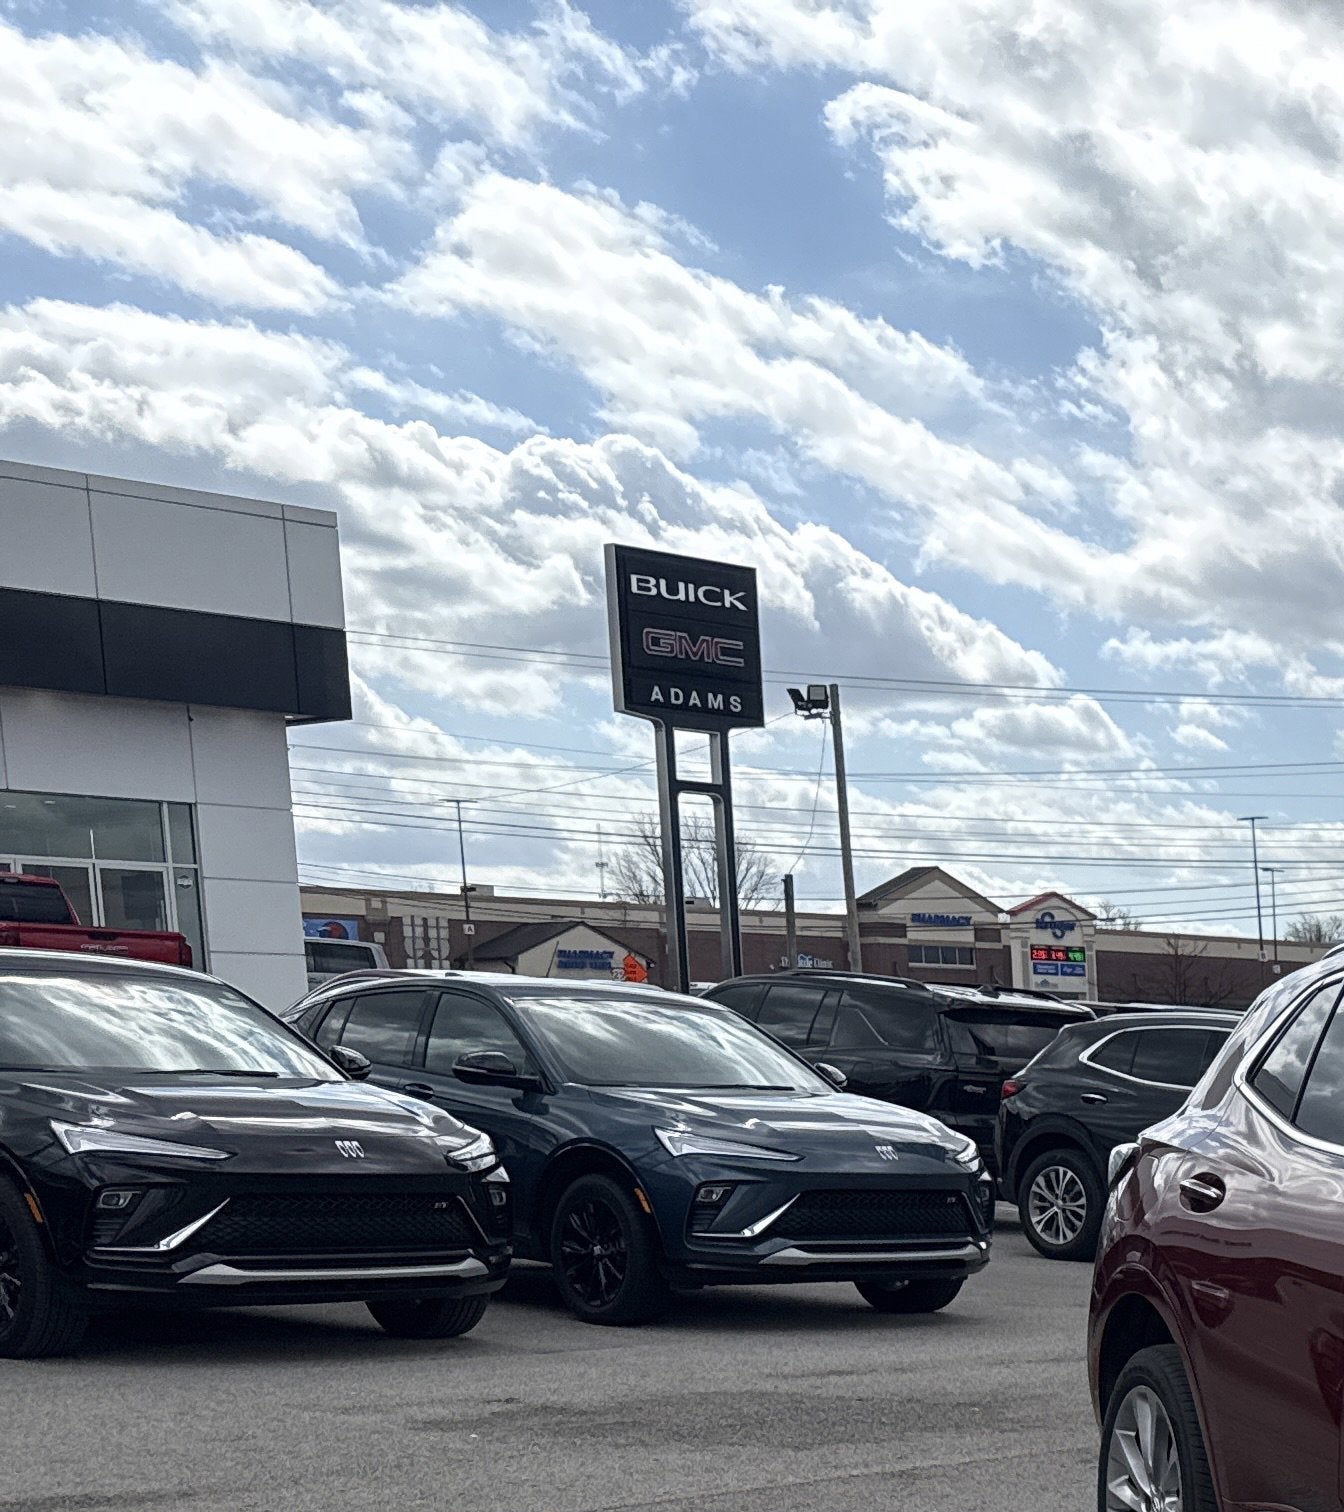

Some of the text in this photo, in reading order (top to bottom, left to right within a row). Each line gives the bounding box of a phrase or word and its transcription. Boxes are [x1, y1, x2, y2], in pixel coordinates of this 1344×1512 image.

[630, 573, 748, 611] BUICK
[642, 627, 745, 667] GMC
[650, 685, 743, 713] ADAMS
